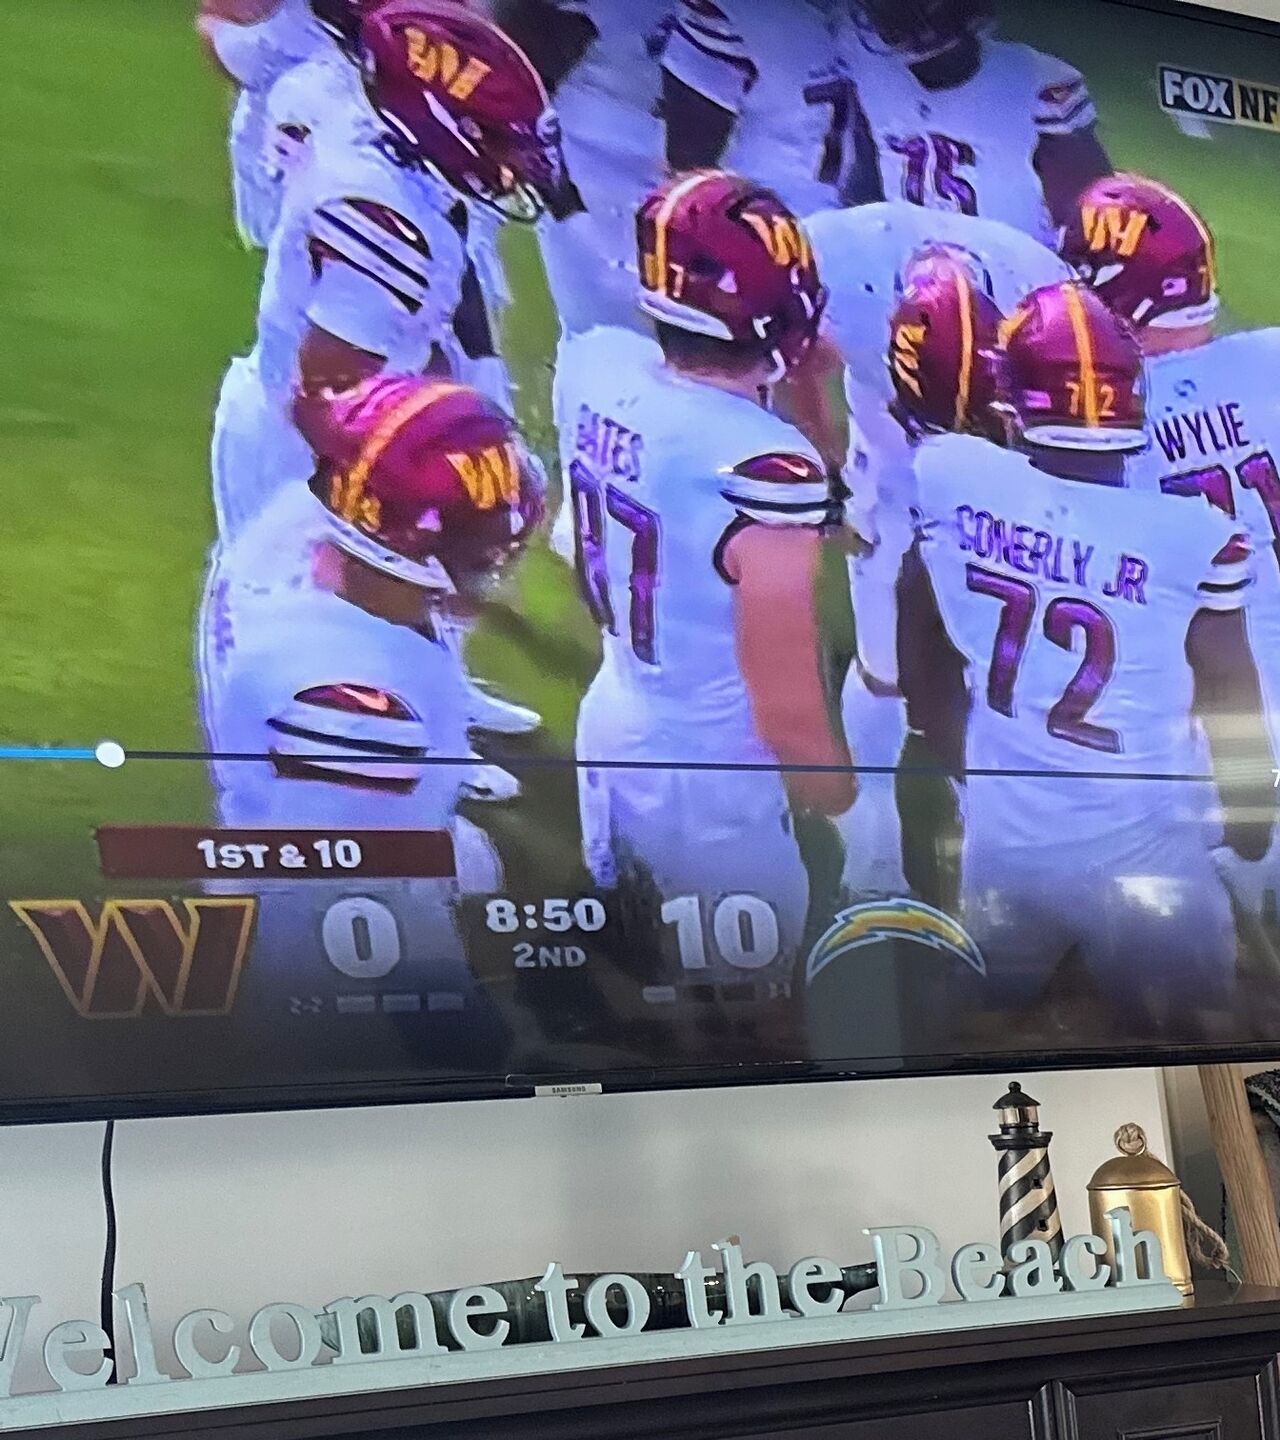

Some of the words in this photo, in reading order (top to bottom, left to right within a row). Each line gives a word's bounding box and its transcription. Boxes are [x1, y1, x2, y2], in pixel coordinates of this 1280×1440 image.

[1162, 71, 1231, 116] FOX
[1153, 402, 1250, 462] WYLIE
[956, 504, 1095, 586] CONERLY
[1102, 553, 1149, 605] JR
[965, 562, 1125, 754] 72
[197, 839, 269, 869] 1ST
[279, 845, 307, 868] &
[313, 839, 362, 868] 10
[321, 898, 399, 979] 0
[485, 900, 607, 933] 8:50
[661, 894, 780, 970] 10
[512, 942, 587, 969] 2ND
[552, 1086, 586, 1094] SAMSUNG
[535, 1262, 650, 1341] to
[675, 1235, 845, 1328] the
[861, 1207, 1169, 1311] Beach
